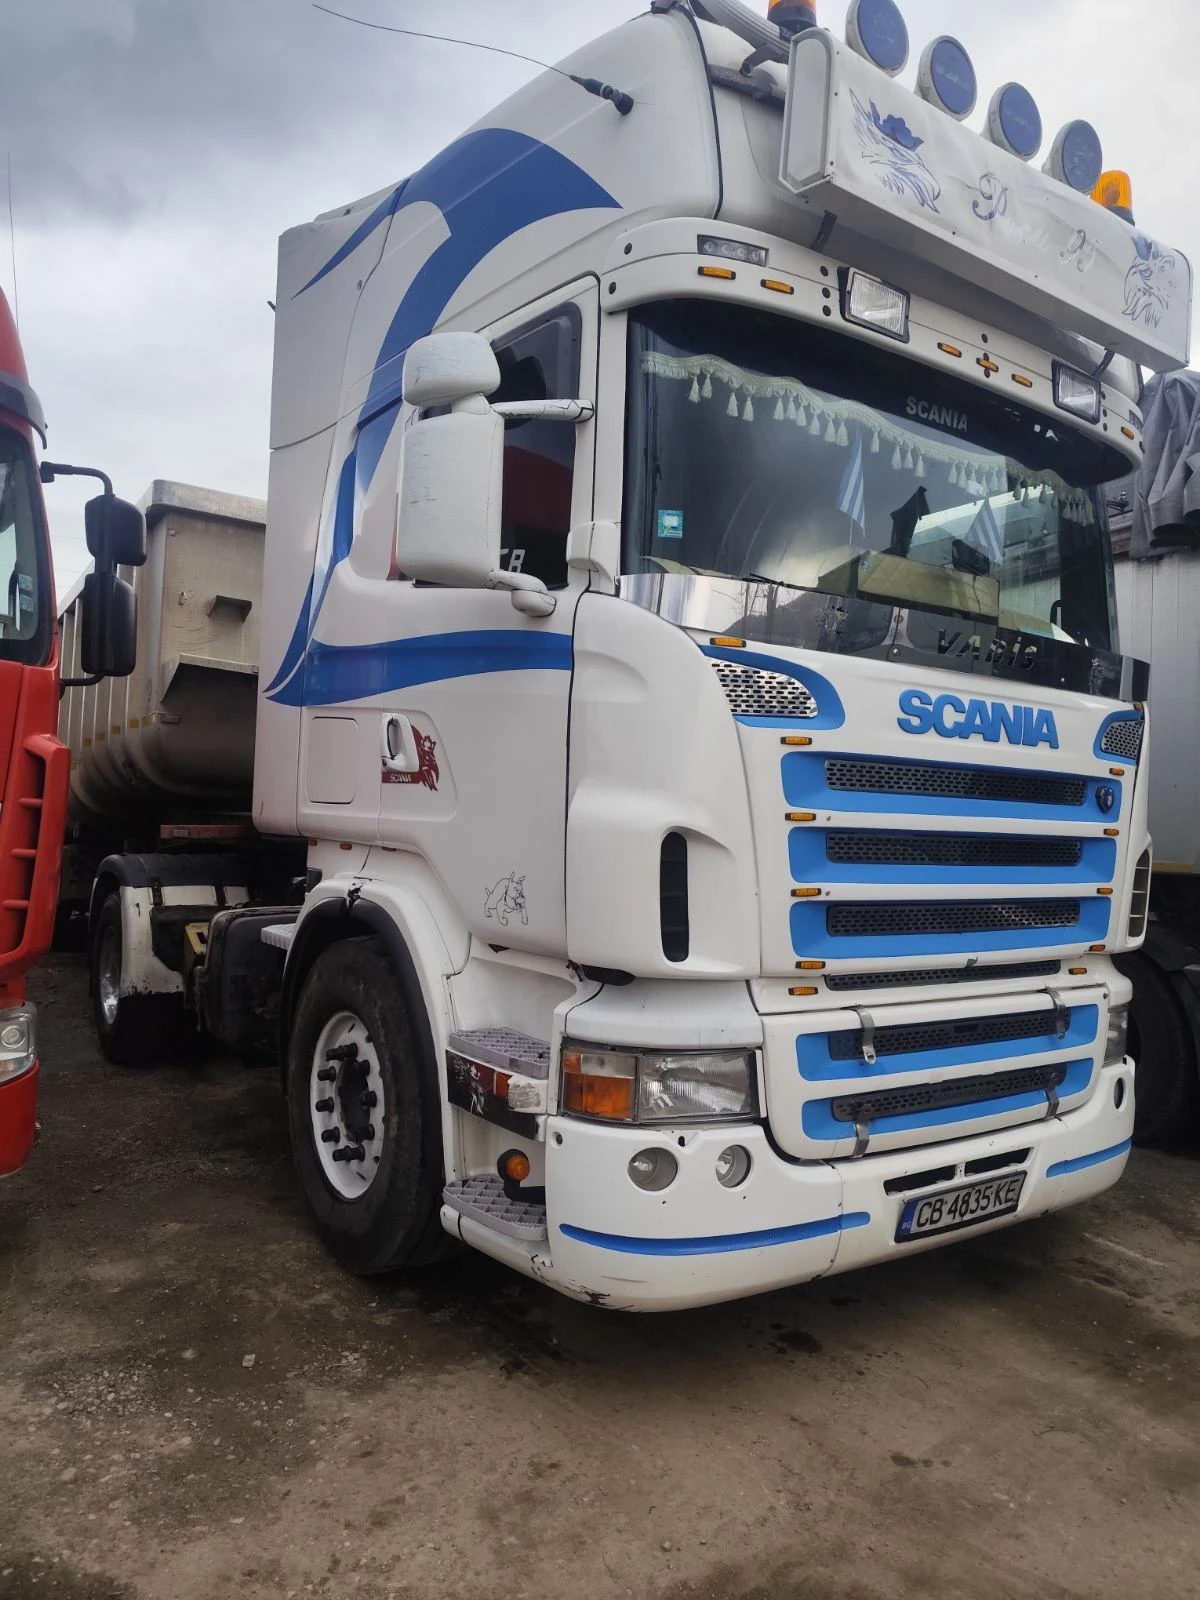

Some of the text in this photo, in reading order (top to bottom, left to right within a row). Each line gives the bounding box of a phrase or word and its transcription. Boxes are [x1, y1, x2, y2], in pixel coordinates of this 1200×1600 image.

[906, 396, 968, 432] SCANIA
[897, 689, 1060, 750] SCANIA
[389, 773, 412, 783] SCANIA
